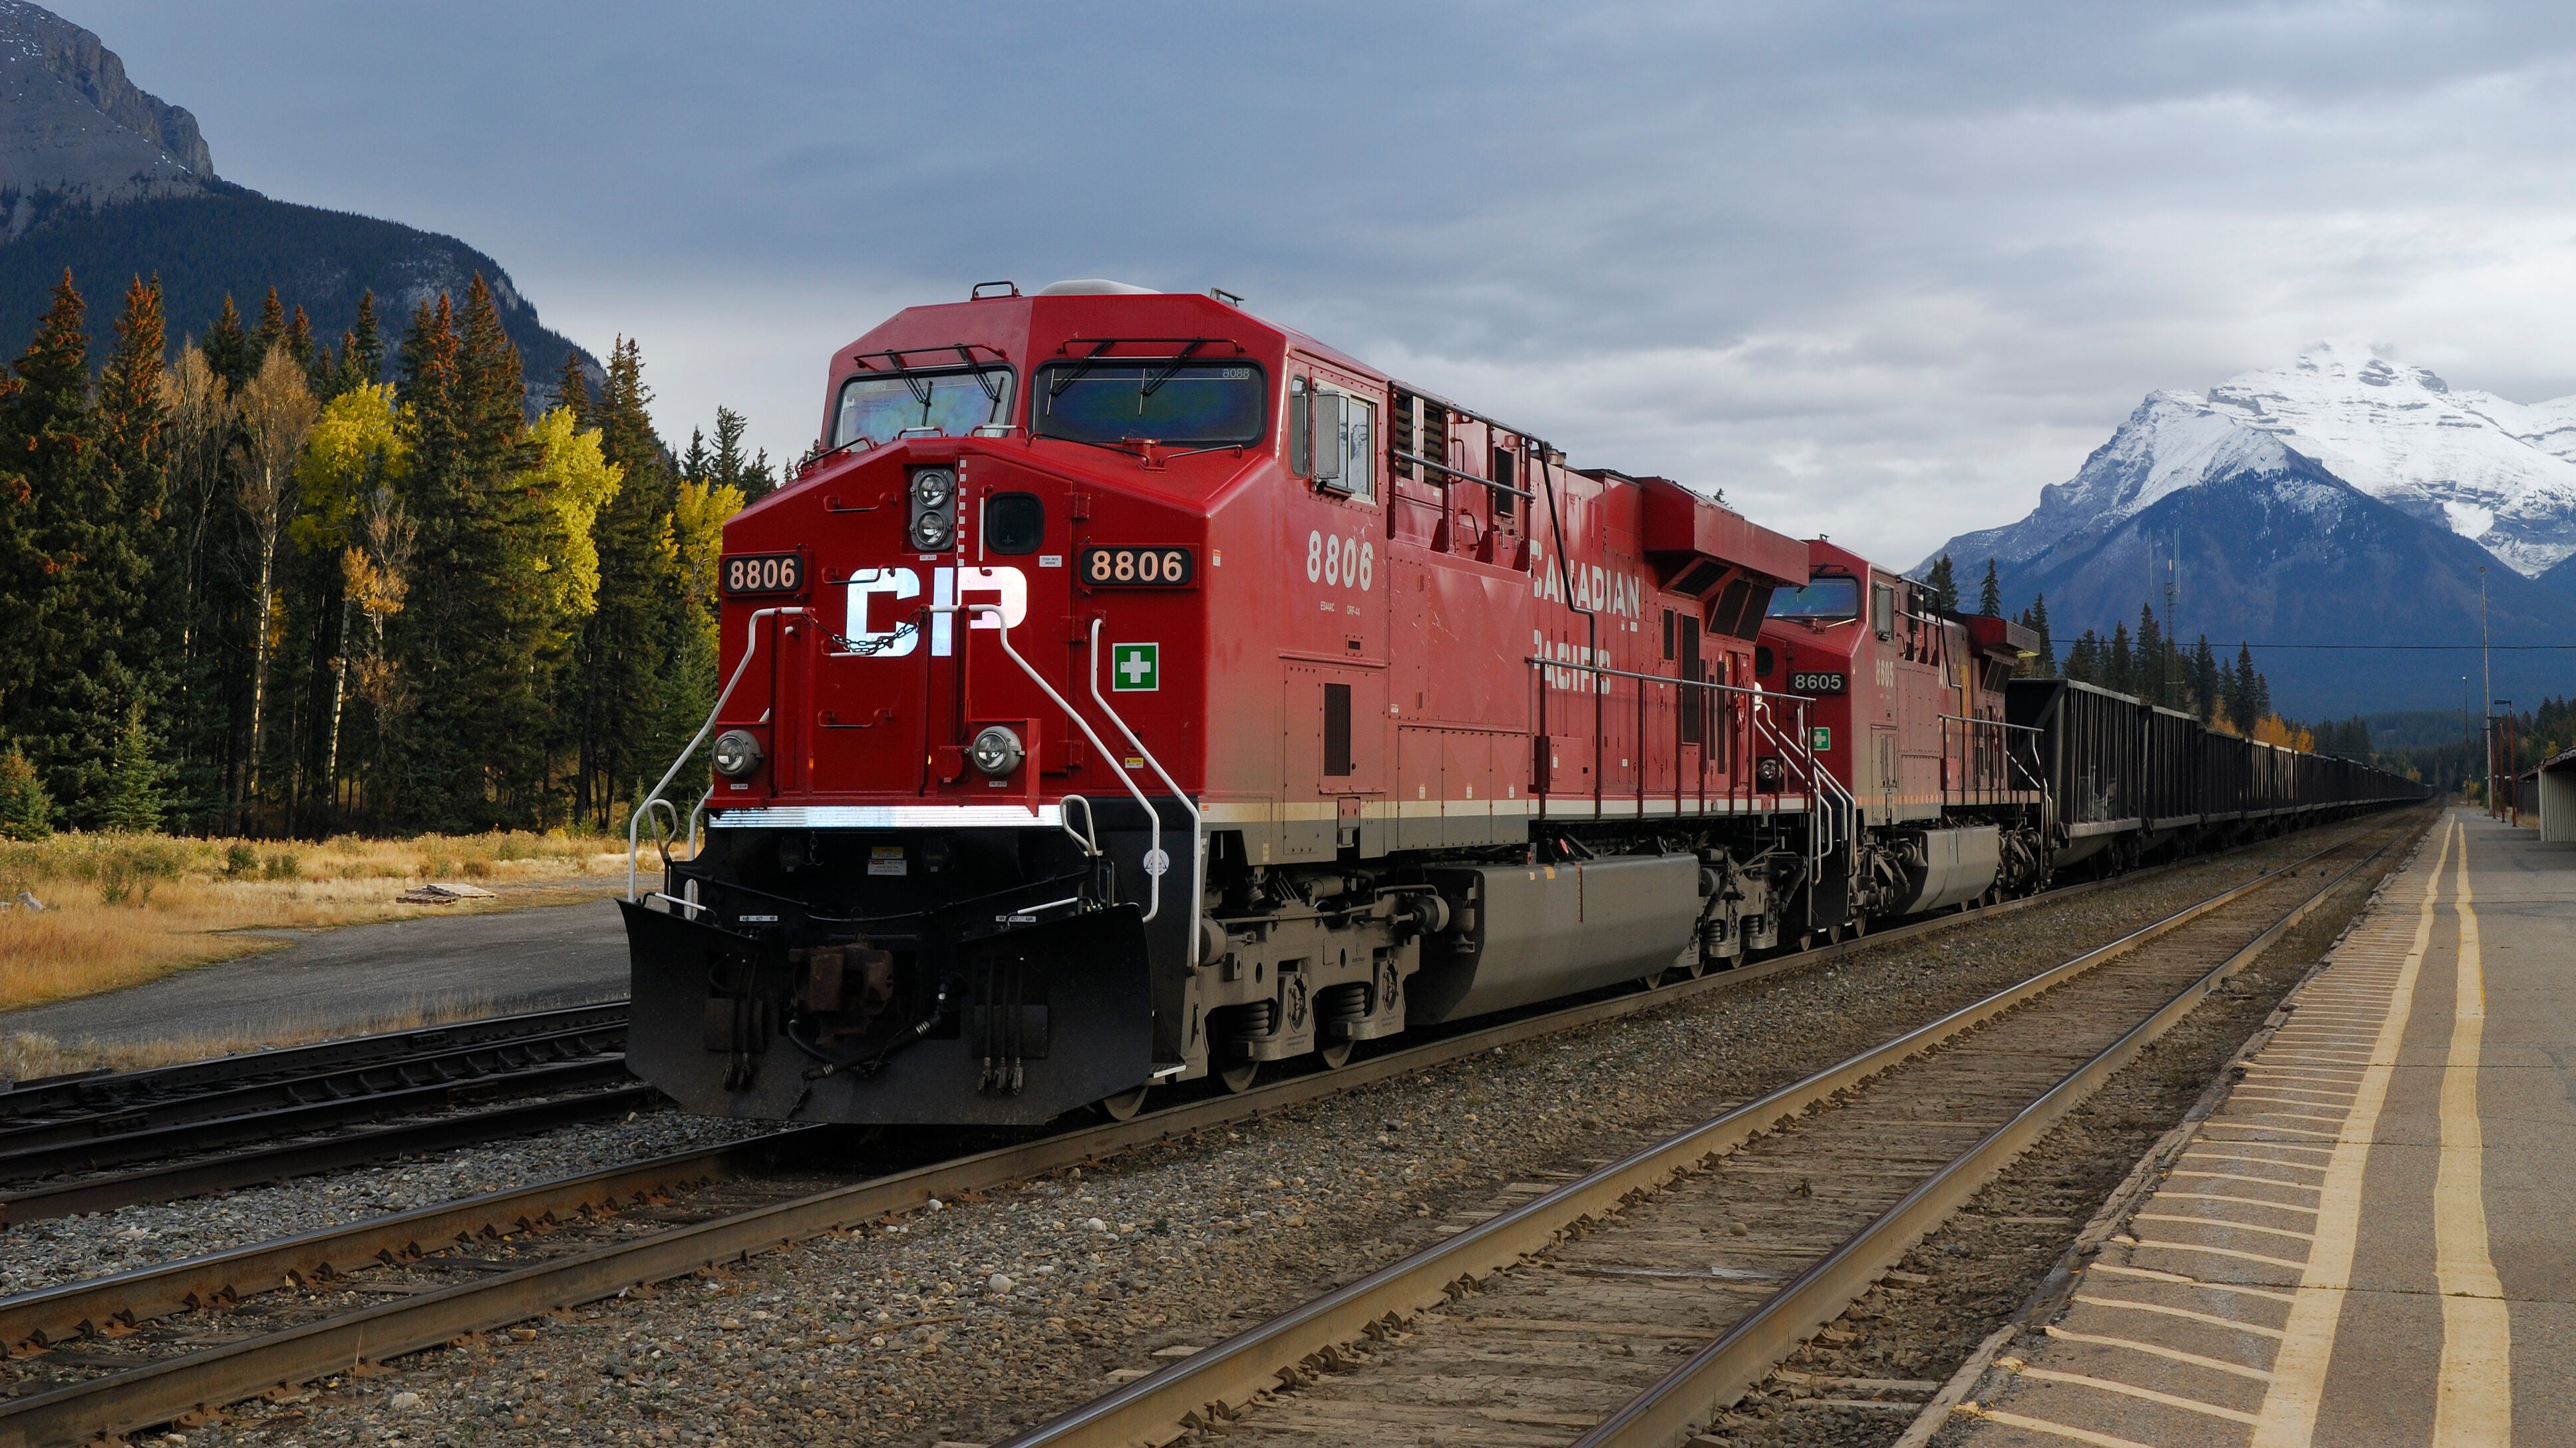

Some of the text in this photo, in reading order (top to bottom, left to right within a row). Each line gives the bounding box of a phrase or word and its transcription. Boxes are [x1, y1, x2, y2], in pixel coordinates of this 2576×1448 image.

[730, 558, 795, 590] 8806
[1091, 550, 1182, 582] 8806
[1307, 530, 1373, 591] 8806
[846, 566, 1027, 657] CP
[1795, 674, 1842, 689] 8605
[1875, 658, 1894, 688] 8605
